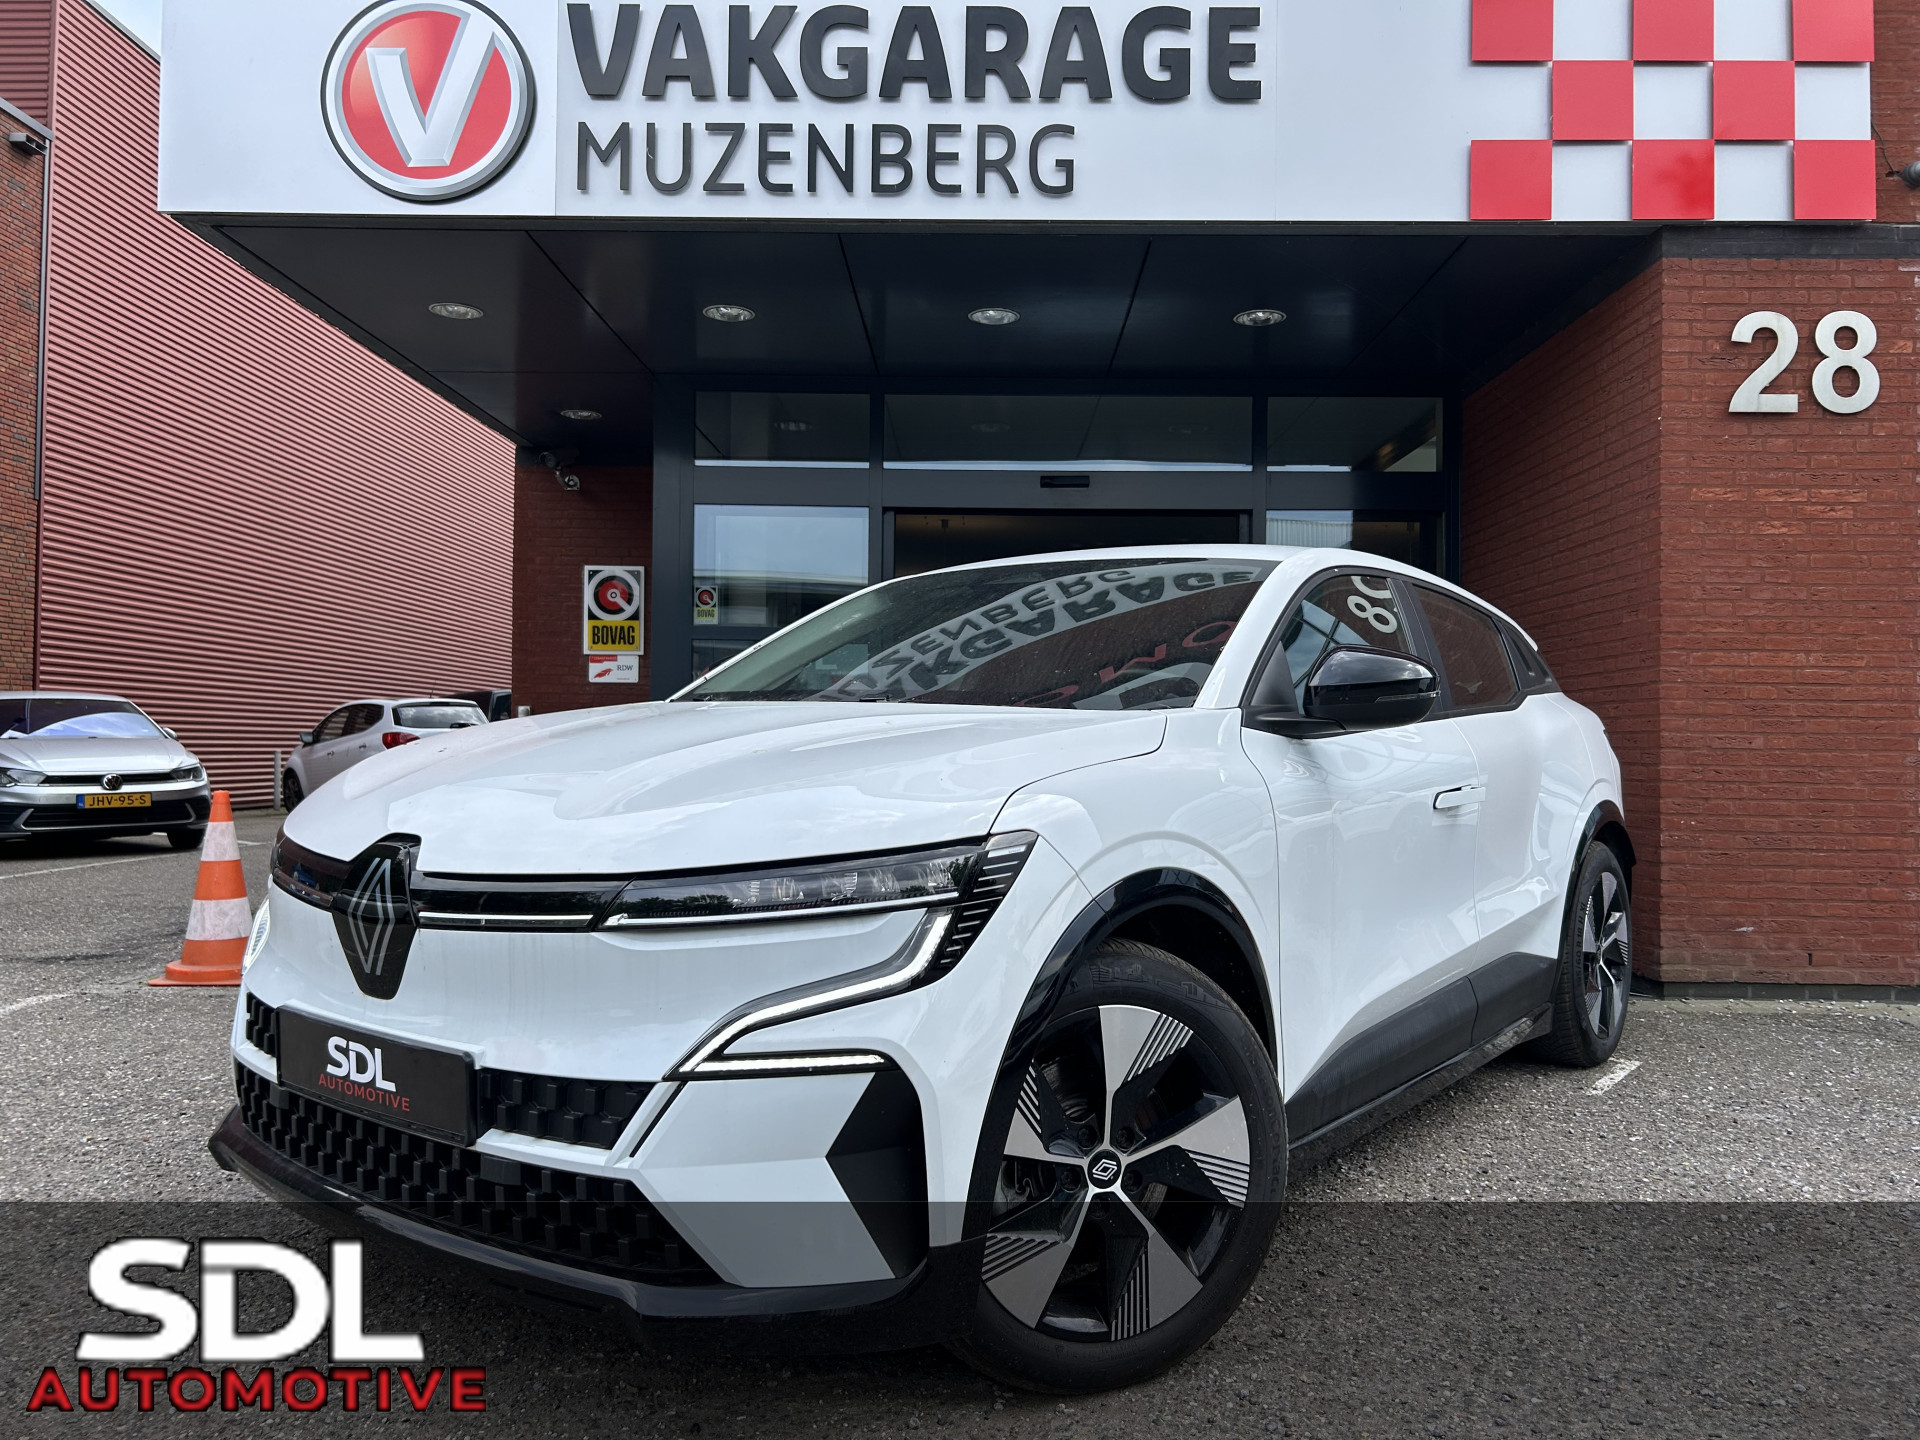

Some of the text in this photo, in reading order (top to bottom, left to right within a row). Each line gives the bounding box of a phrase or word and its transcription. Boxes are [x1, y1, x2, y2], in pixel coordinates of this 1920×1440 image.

[567, 3, 1261, 101] VAKGARAGE
[577, 121, 1076, 197] MUZENBERG
[1729, 310, 1881, 415] 28
[592, 625, 635, 645] BOVAG
[697, 608, 714, 618] BOVAG
[88, 794, 147, 807] JHV-95-S
[326, 1036, 396, 1092] SDL
[318, 1073, 411, 1112] AUTOMOTIVE
